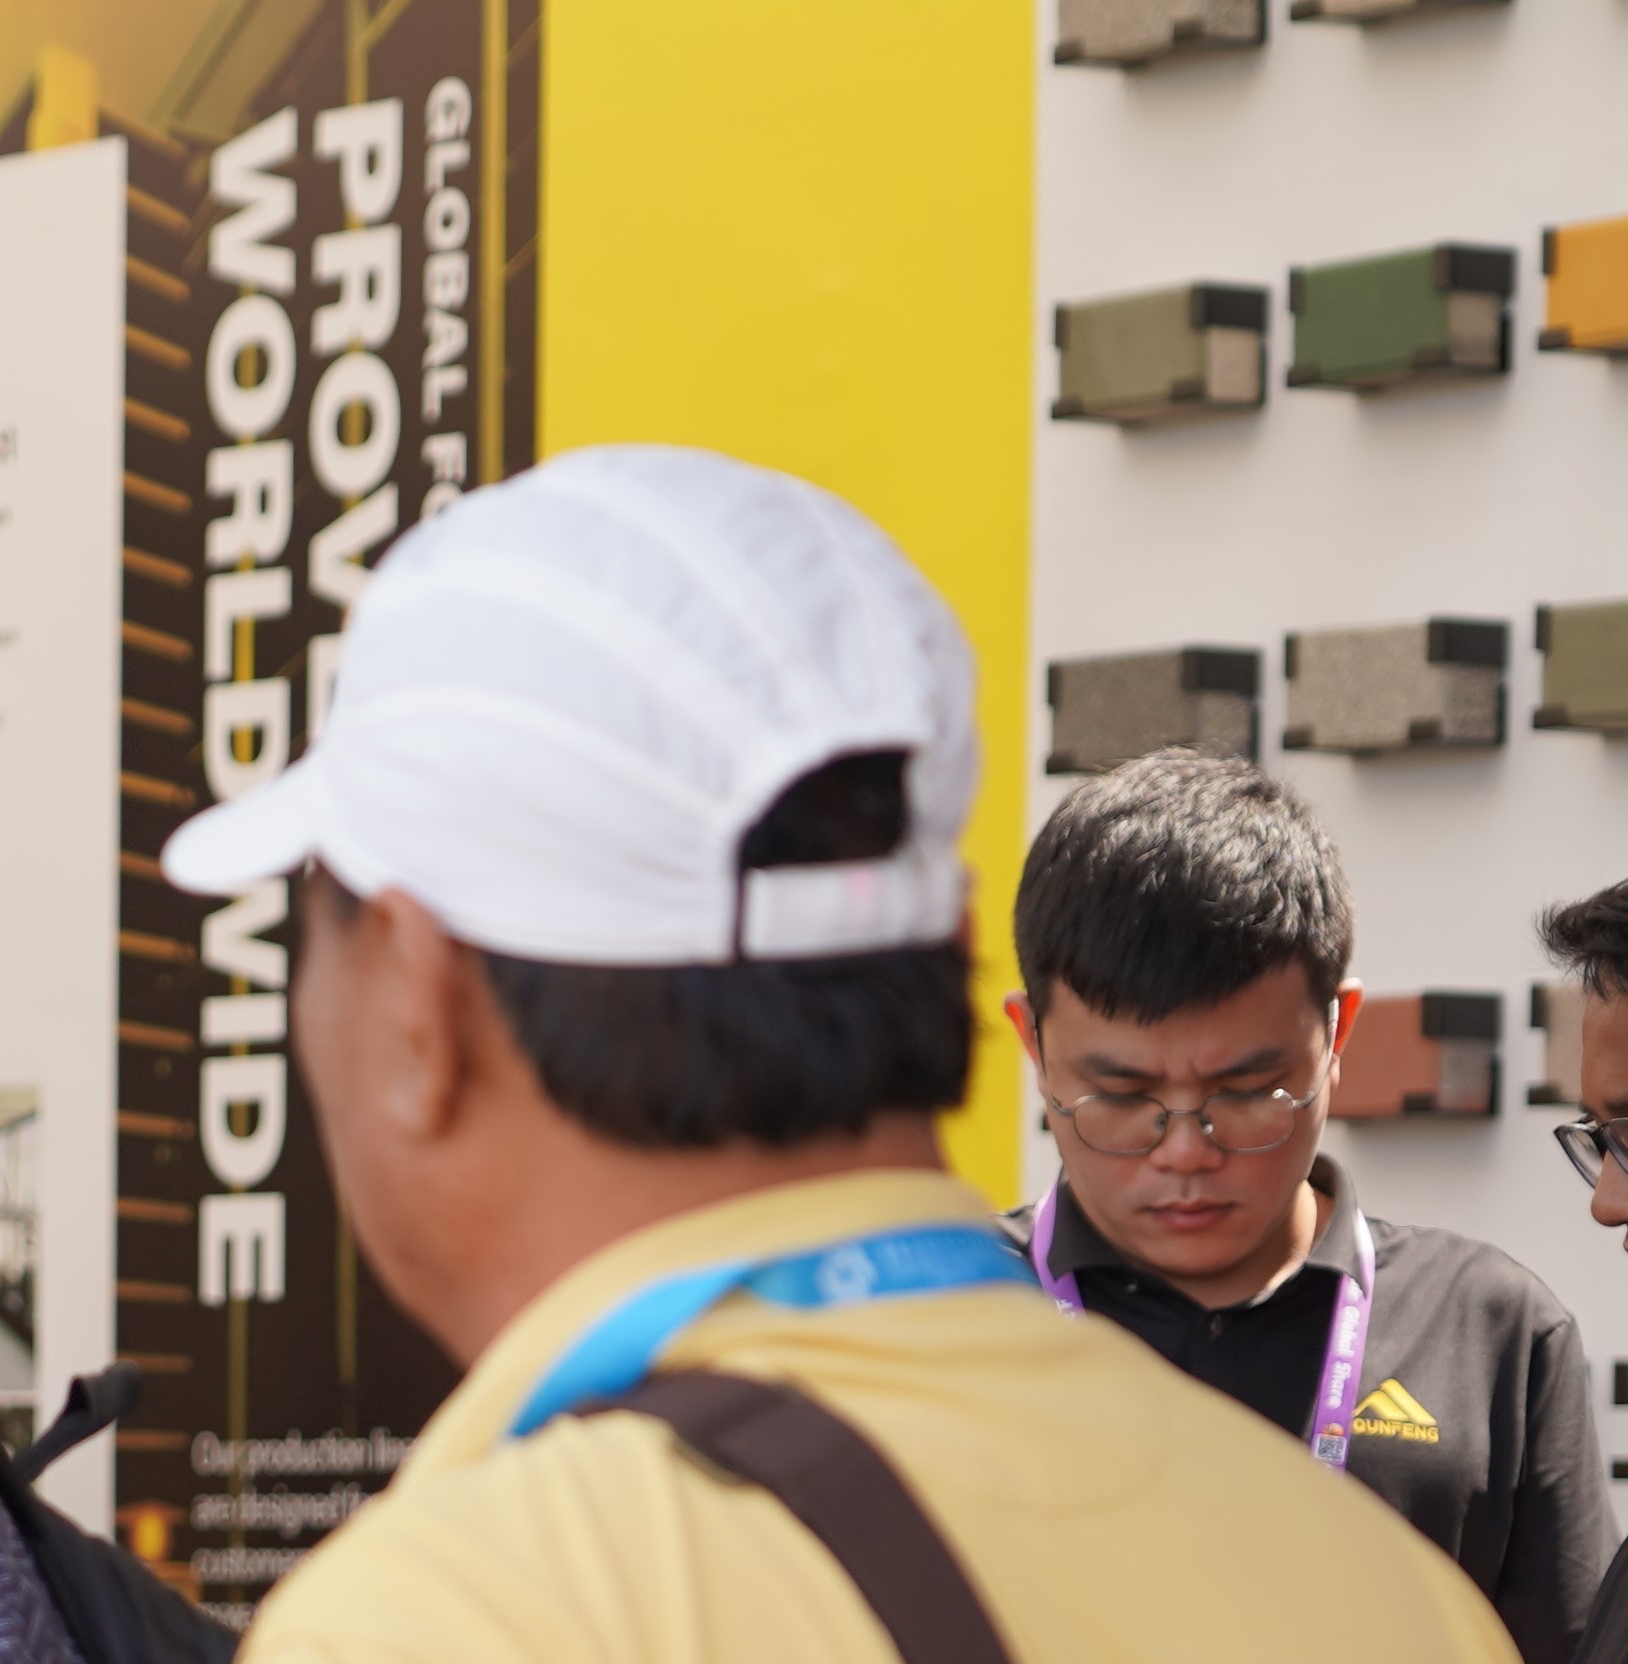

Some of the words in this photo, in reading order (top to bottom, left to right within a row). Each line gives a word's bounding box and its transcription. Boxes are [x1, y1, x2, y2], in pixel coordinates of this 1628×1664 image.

[420, 75, 474, 424] GLOBAL
[191, 1431, 239, 1475] Our
[242, 1429, 369, 1480] production
